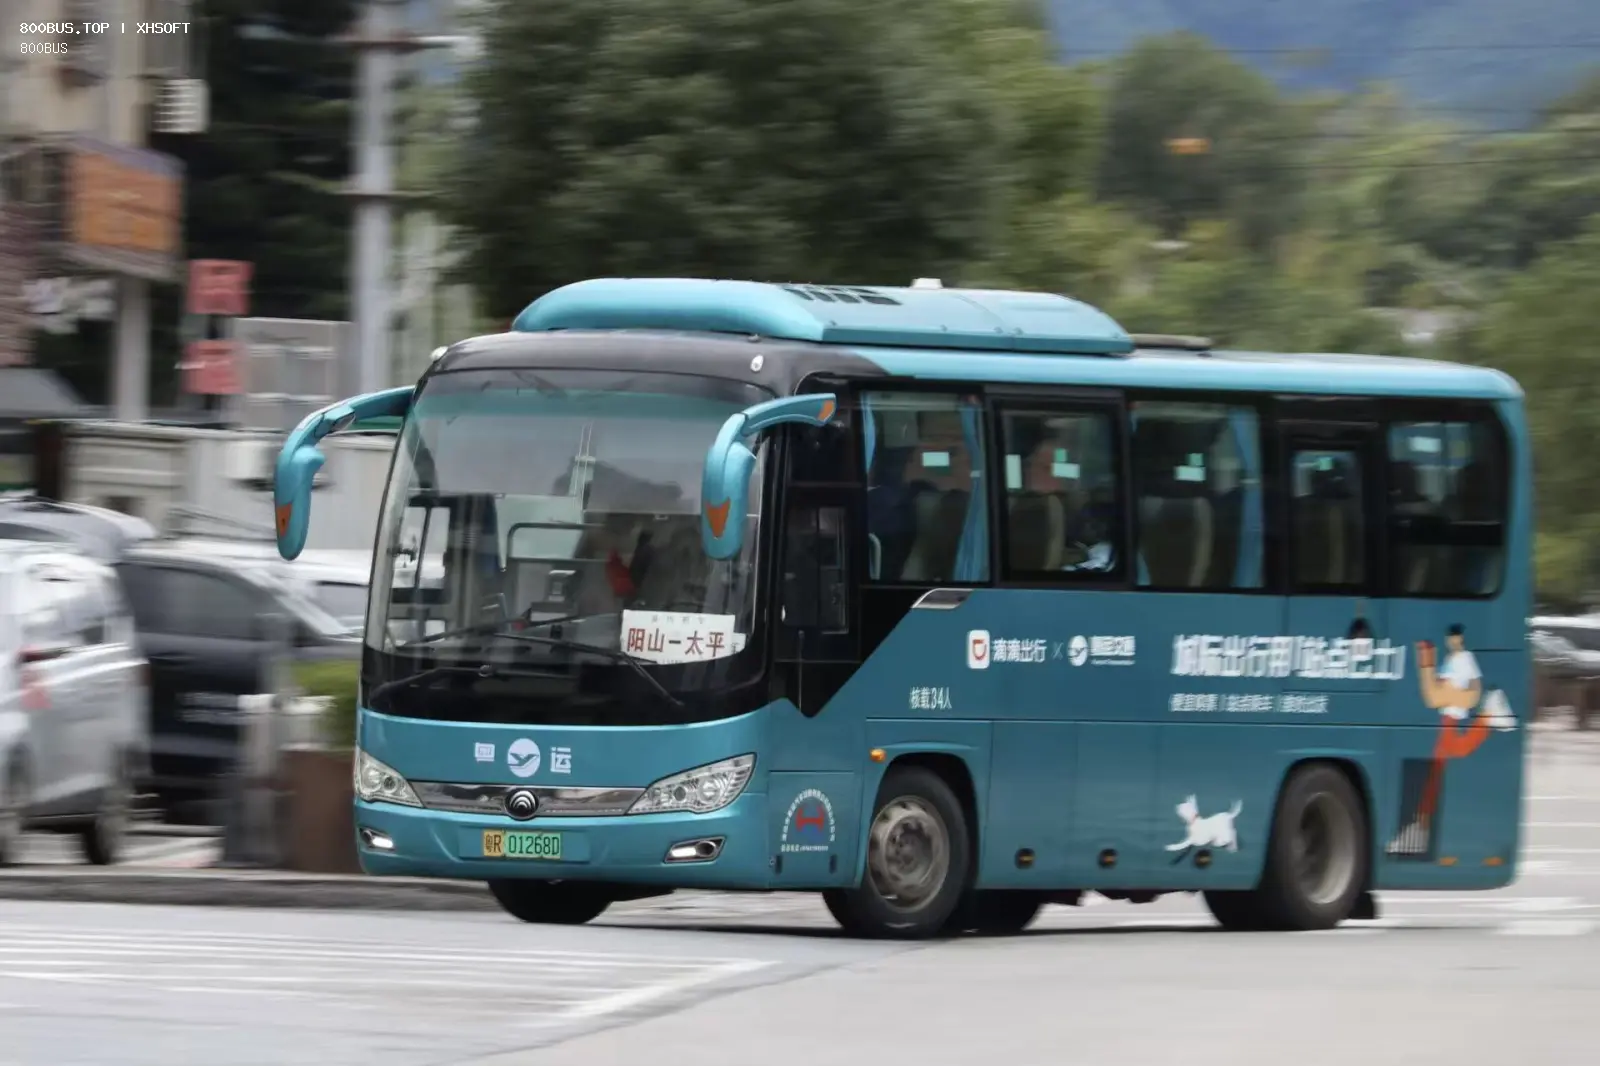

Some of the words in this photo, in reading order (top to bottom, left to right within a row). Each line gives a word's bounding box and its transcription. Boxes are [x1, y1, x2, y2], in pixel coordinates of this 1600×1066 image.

[991, 637, 1047, 663] 滴滴出行
[909, 686, 953, 710] 核载34人
[549, 746, 573, 775] 运
